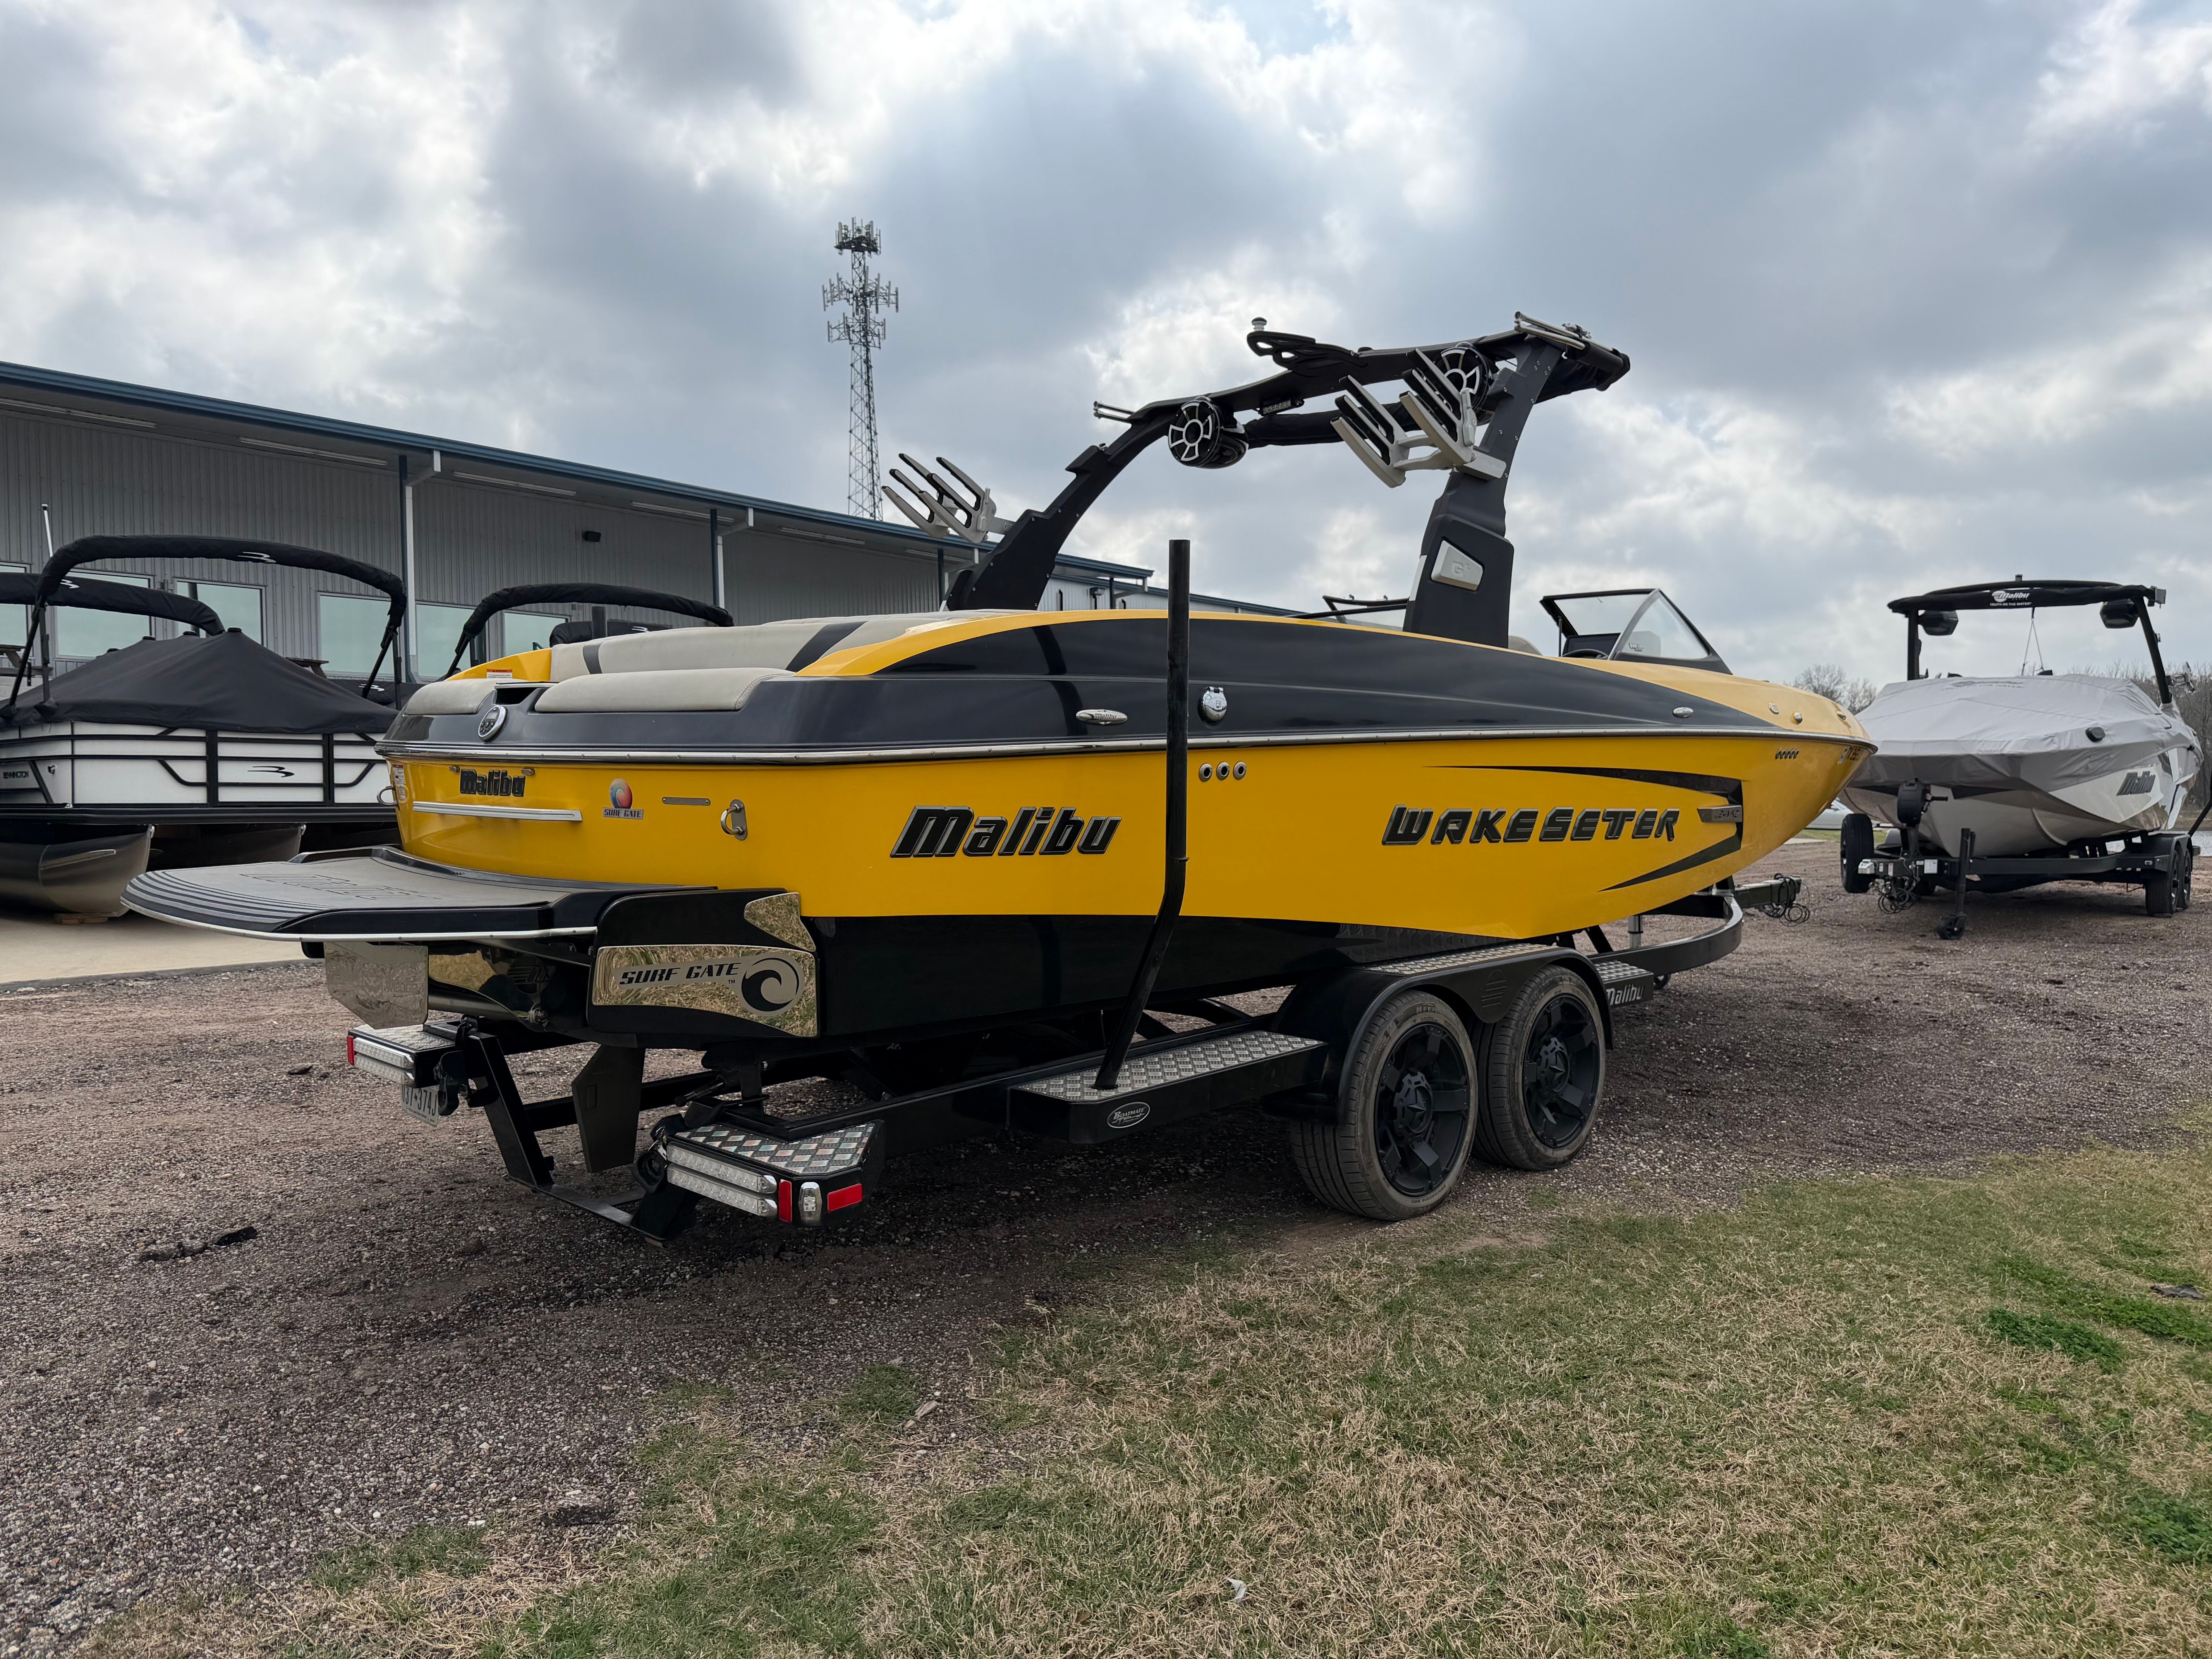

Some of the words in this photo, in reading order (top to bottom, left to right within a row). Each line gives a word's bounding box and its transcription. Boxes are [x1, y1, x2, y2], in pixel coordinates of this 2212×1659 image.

[460, 769, 526, 797] Malibu
[604, 809, 622, 817] SURF
[624, 810, 642, 818] GATE
[890, 805, 1122, 858] Malibu
[619, 967, 681, 985] SURF
[685, 962, 742, 979] GATE
